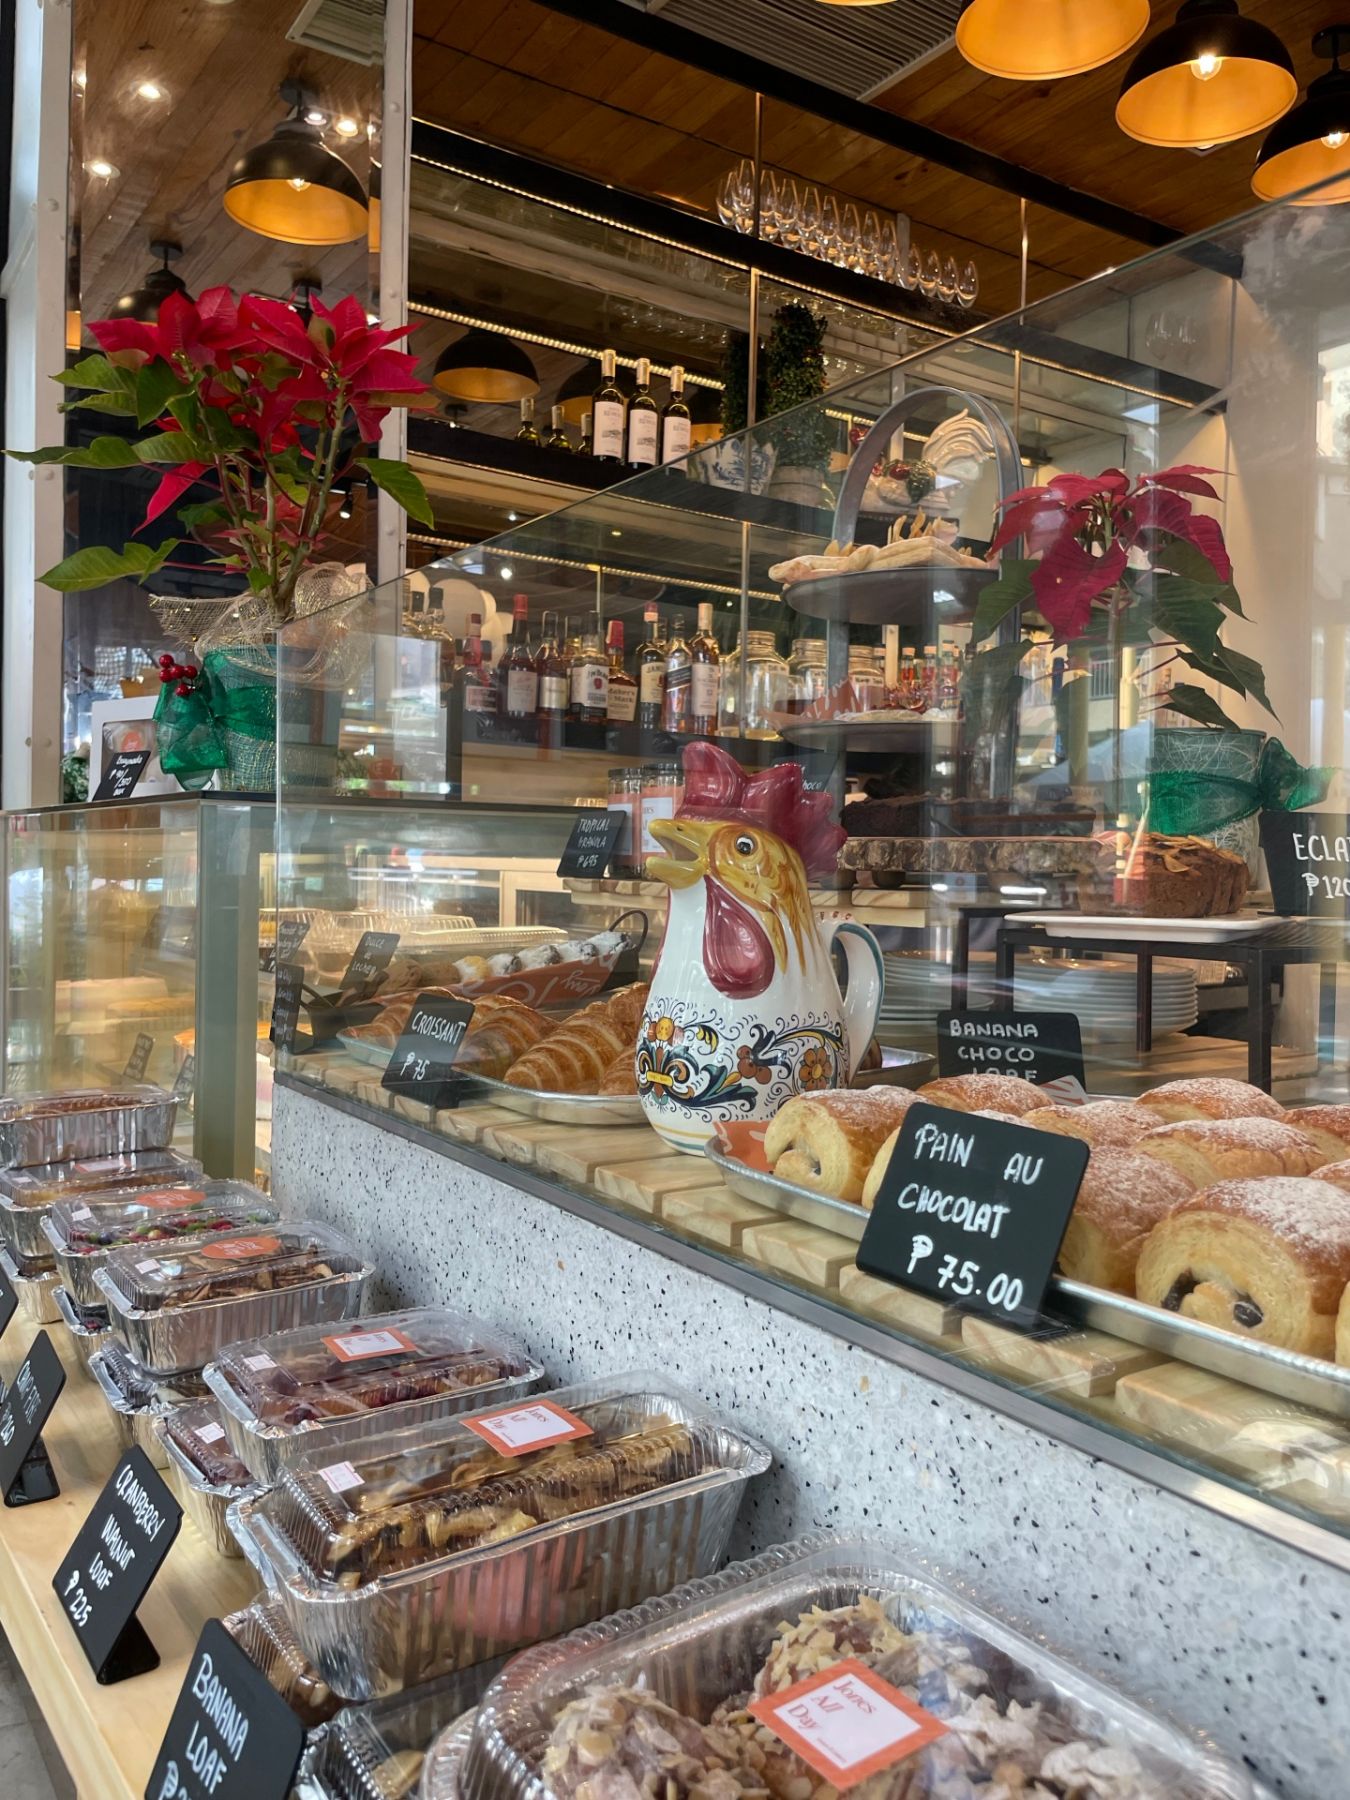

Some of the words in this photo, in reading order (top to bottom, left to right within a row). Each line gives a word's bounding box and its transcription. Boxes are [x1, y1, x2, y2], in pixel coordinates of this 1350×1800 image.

[578, 818, 610, 833] TROPICAL
[1292, 832, 1350, 862] ECLA
[411, 1010, 467, 1046] CROISSANT
[950, 1018, 1039, 1038] BANANA
[412, 1058, 431, 1081] 75
[957, 1046, 1035, 1063] CHOCO
[914, 1122, 975, 1168] PAIN
[1003, 1152, 1044, 1186] AU
[897, 1182, 1012, 1239] CHOCOLAT
[937, 1253, 1024, 1312] 75.00
[115, 1464, 166, 1542] CRANBERRY
[100, 1513, 135, 1571] WALNUT
[69, 1588, 93, 1627] 225
[192, 1652, 249, 1762] BANANA
[810, 1694, 845, 1713] All
[833, 1680, 878, 1715] Jones
[787, 1703, 822, 1730] Day
[185, 1720, 228, 1795] LOAF
